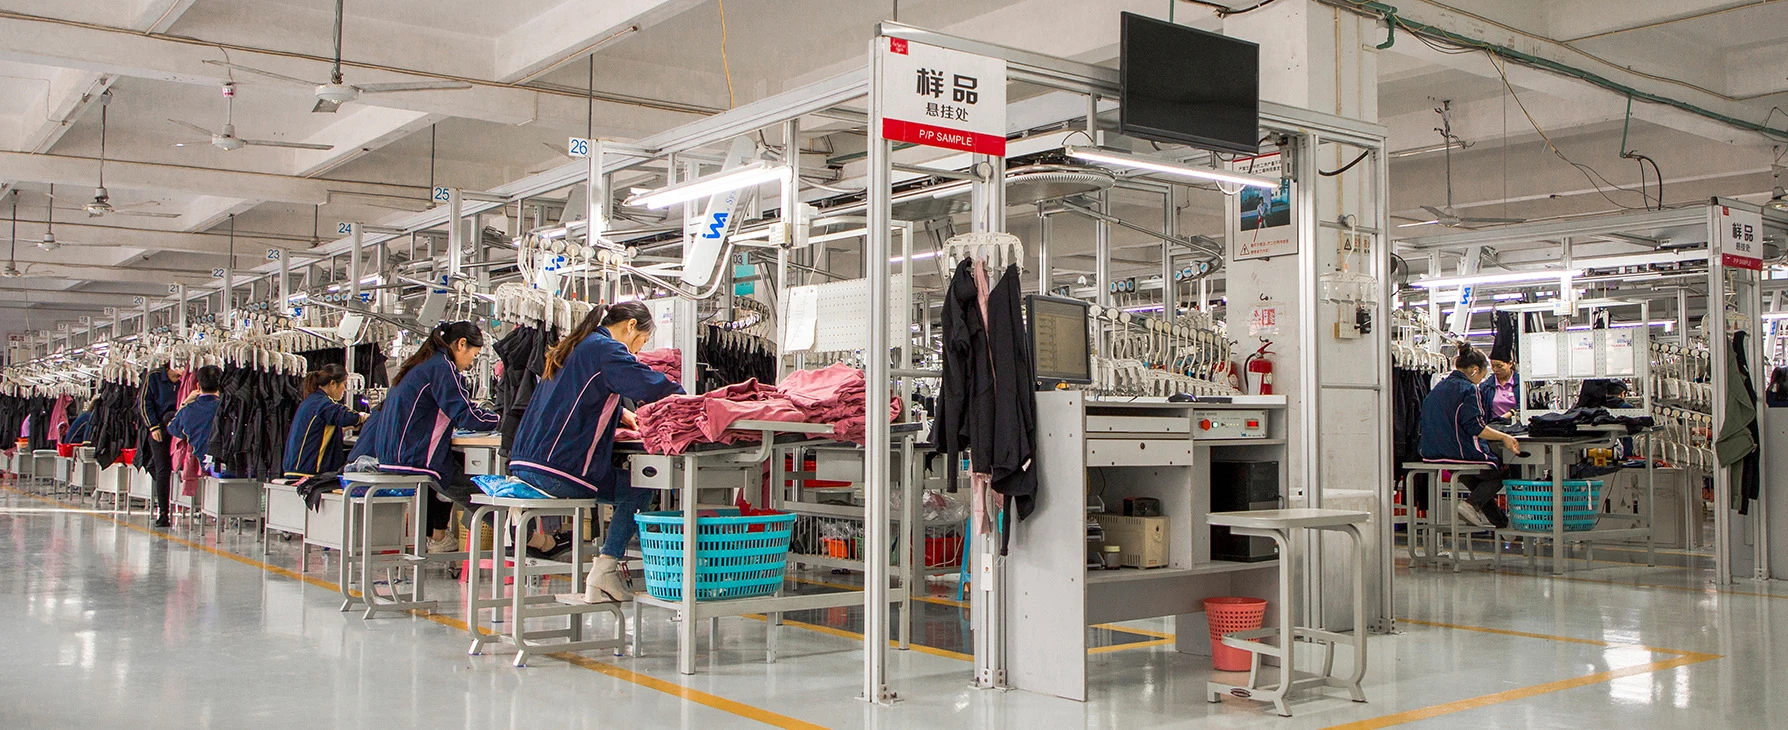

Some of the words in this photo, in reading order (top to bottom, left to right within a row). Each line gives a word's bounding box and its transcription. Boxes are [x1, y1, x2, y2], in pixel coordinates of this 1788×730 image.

[916, 67, 978, 104] 样品
[926, 102, 968, 122] 悬挂处
[919, 129, 935, 139] P/P
[936, 132, 972, 146] SAMPLE
[570, 138, 588, 155] 26
[434, 187, 450, 201] 25
[338, 222, 352, 234] 24
[1732, 222, 1754, 242] 样品
[267, 248, 280, 259] 23
[733, 253, 743, 265] 03
[213, 268, 225, 278] 22
[169, 284, 180, 293] 21
[134, 296, 144, 304] 20
